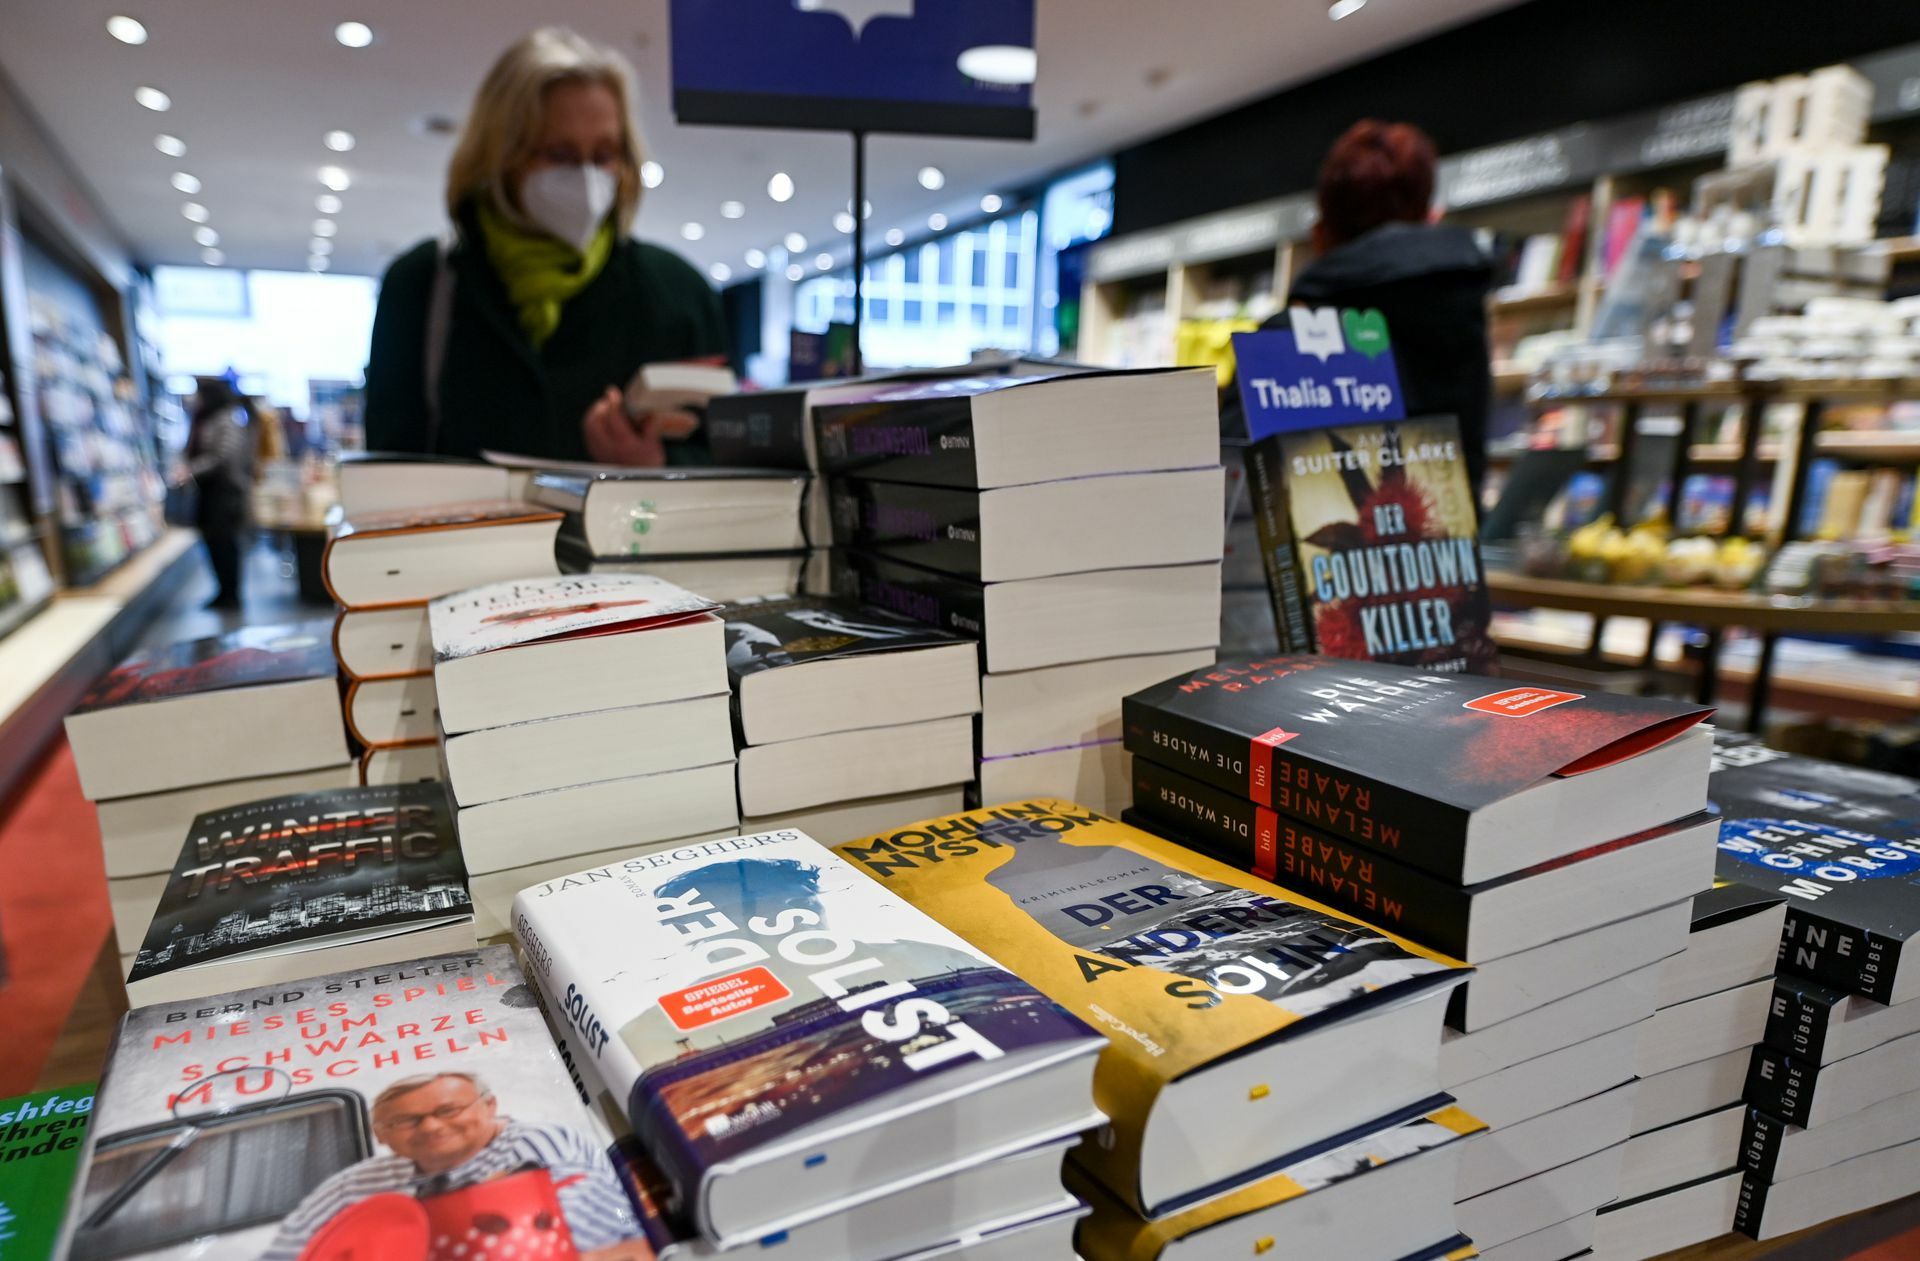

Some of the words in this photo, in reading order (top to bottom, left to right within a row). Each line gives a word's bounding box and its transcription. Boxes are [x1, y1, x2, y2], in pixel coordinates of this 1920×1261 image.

[1250, 376, 1333, 409] Thalia
[1333, 376, 1393, 414] Tipp
[1291, 450, 1371, 477] SUITER
[1376, 441, 1457, 467] CLARKE
[1358, 432, 1399, 449] AMY
[1372, 503, 1406, 536] DER
[1311, 537, 1479, 603] COUNTDOWN
[1359, 598, 1456, 657] KILLER
[1300, 675, 1452, 724] WÄLDER
[1312, 676, 1379, 700] DIE
[1381, 690, 1456, 719] THRILLER
[1152, 730, 1210, 763] WÄLDER
[1260, 731, 1285, 745] btb
[1216, 753, 1243, 776] DIE
[1255, 764, 1266, 788] btb
[1279, 760, 1372, 812] RAABE
[1160, 786, 1217, 824] WÄLDER
[1222, 812, 1248, 838] DIE
[1279, 786, 1401, 849] MELANIE
[196, 803, 434, 861] WINTER
[841, 801, 1045, 862] MOHLIN
[864, 811, 1117, 878] NYSTRÖM
[1260, 829, 1271, 852] btb
[1283, 826, 1373, 884] RAABE
[1717, 819, 1821, 854] WELT
[1763, 829, 1877, 869] OHNE
[181, 830, 440, 898] TRAFFIC
[538, 868, 613, 898] JAN
[623, 829, 800, 873] SEGHERS
[618, 874, 647, 899] ROMAN
[1018, 865, 1150, 905] KRIMINALROMAN
[1284, 852, 1403, 922] MELANIE
[1778, 836, 1920, 901] MORGE
[655, 886, 771, 967] DER
[1060, 882, 1189, 929] DER
[517, 913, 553, 977] SEGHERS
[1073, 895, 1303, 984] ANDERE
[165, 990, 305, 1025] BERND
[324, 957, 485, 995] STELTER
[681, 976, 750, 1004] SPIEGEL
[747, 907, 1005, 1072] SOLIST
[1164, 933, 1358, 1011] SOHN
[1859, 940, 1884, 994] LÜBBE
[151, 1001, 349, 1051] MIESES
[372, 972, 509, 1009] SPIEL
[564, 983, 610, 1060] SOLIST
[680, 983, 767, 1016] Bestseller-
[709, 995, 755, 1018] Autor
[181, 1007, 488, 1083] SCHWARZE
[299, 1011, 379, 1040] UM
[1793, 1003, 1815, 1054] LÜBBE
[165, 1026, 510, 1112] MUSCHELN
[1780, 1067, 1802, 1118] LÜBBE
[1746, 1120, 1768, 1170] LÜBBE
